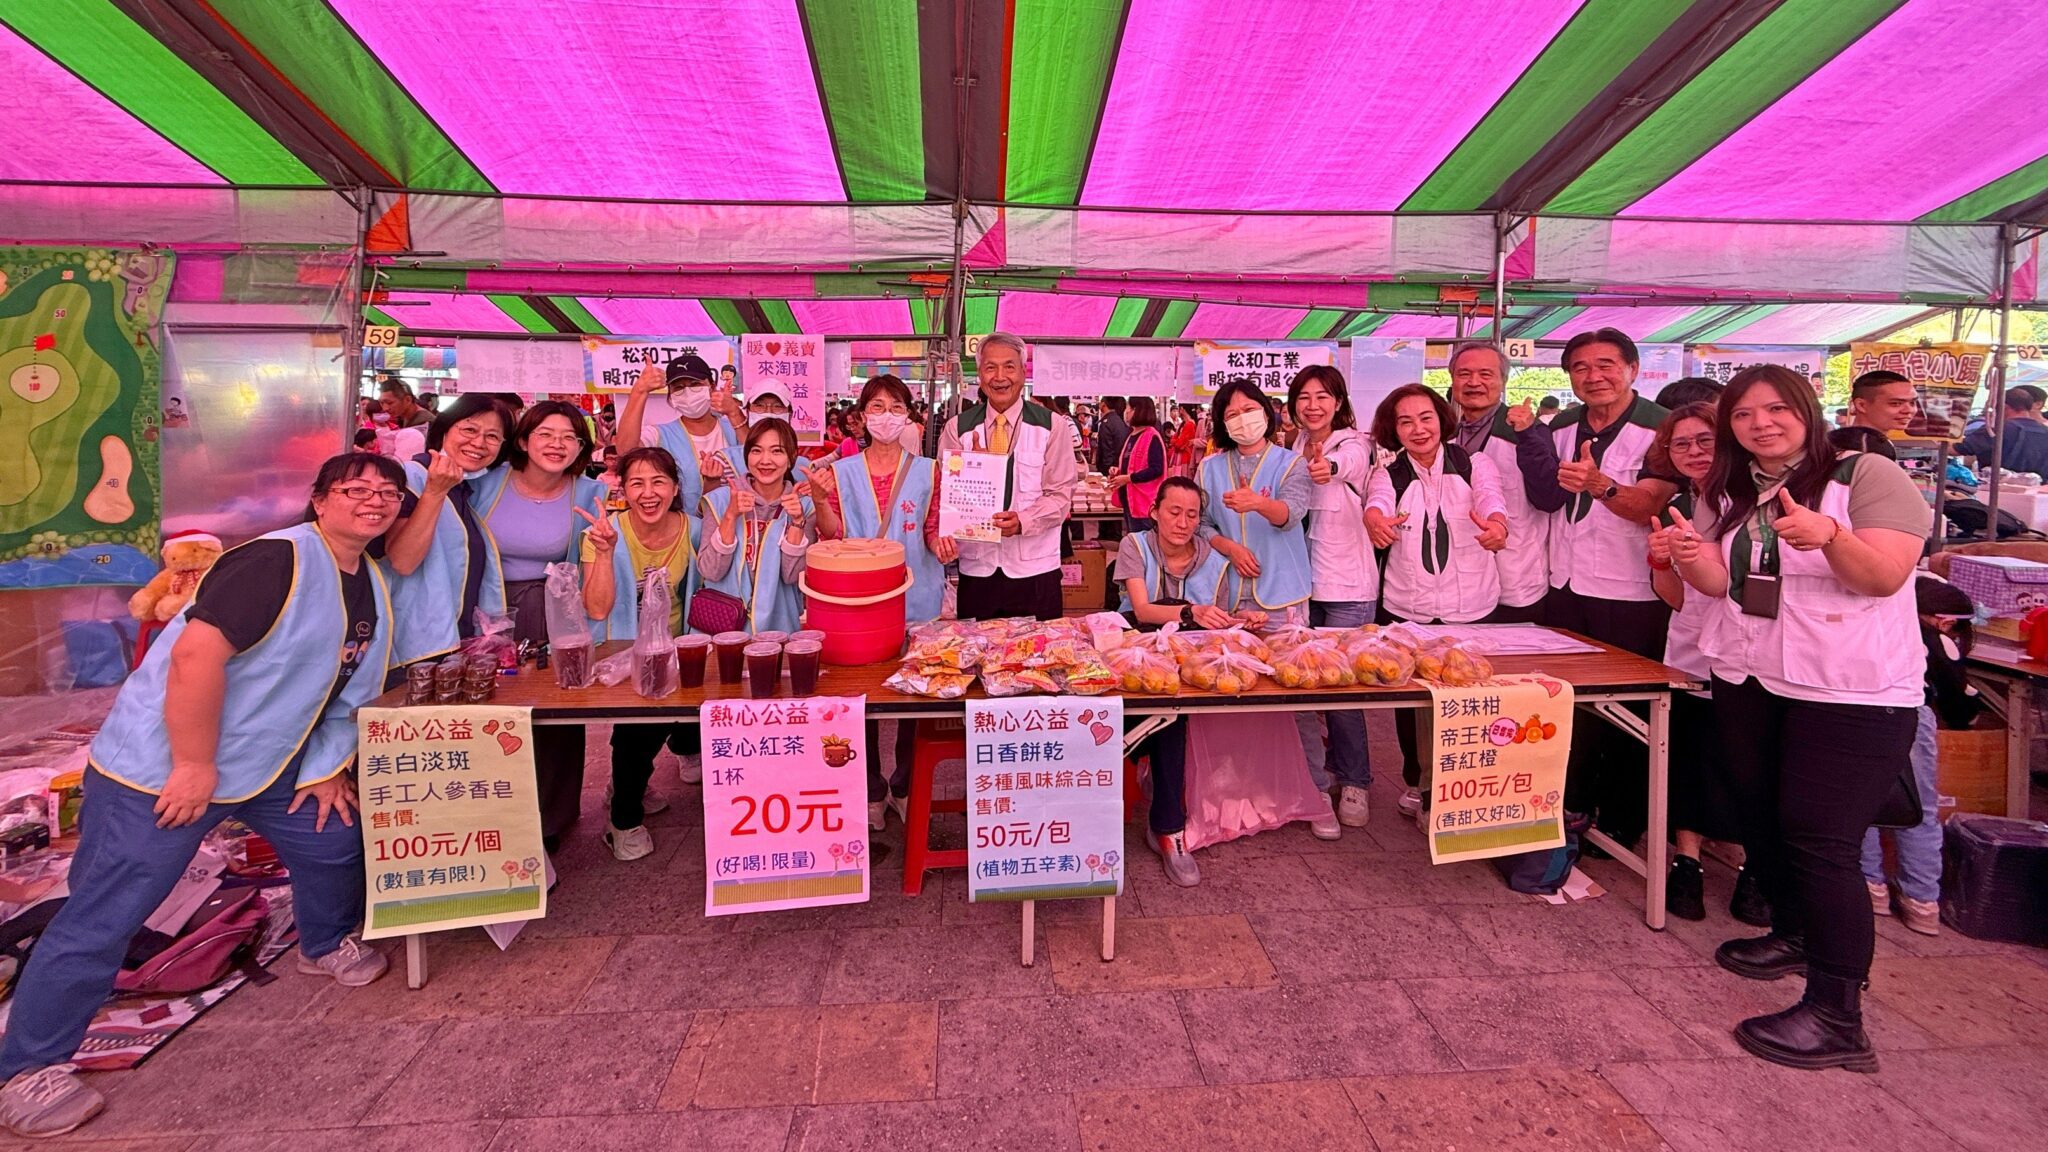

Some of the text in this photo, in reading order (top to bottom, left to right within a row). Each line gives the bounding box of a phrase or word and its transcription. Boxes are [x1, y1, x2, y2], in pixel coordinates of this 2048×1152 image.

[54, 309, 67, 318] 50
[368, 328, 396, 346] 59
[968, 337, 979, 354] 6
[1227, 351, 1300, 369] 松和工業
[1509, 343, 1529, 358] 61
[2017, 345, 2042, 360] 62
[757, 360, 808, 377] 來淘寶
[709, 702, 810, 728] 熱心公益
[1440, 695, 1502, 719] 珍珠柑
[367, 718, 473, 744] 熱心公益
[974, 708, 1070, 733] 熱心公益
[711, 735, 805, 759] 愛心紅茶
[976, 740, 1065, 765] 日香餅乾
[366, 751, 471, 777] 美白淡斑
[1439, 749, 1498, 773] 香紅橙
[712, 767, 745, 786] 1杯
[974, 769, 1114, 793] 多種風味綜合包
[1438, 772, 1533, 803] 100元/包
[368, 780, 514, 806] 手工人參香皂
[730, 789, 844, 837] 20元
[974, 796, 1016, 816] 售價:
[1435, 804, 1527, 830] (香甜又好吃)
[370, 809, 420, 829] 售價:
[374, 830, 502, 861] 100元/個
[976, 820, 1071, 848] 50元/包
[375, 864, 487, 894] (數量有限!)
[976, 854, 1082, 880] (植物五辛素)
